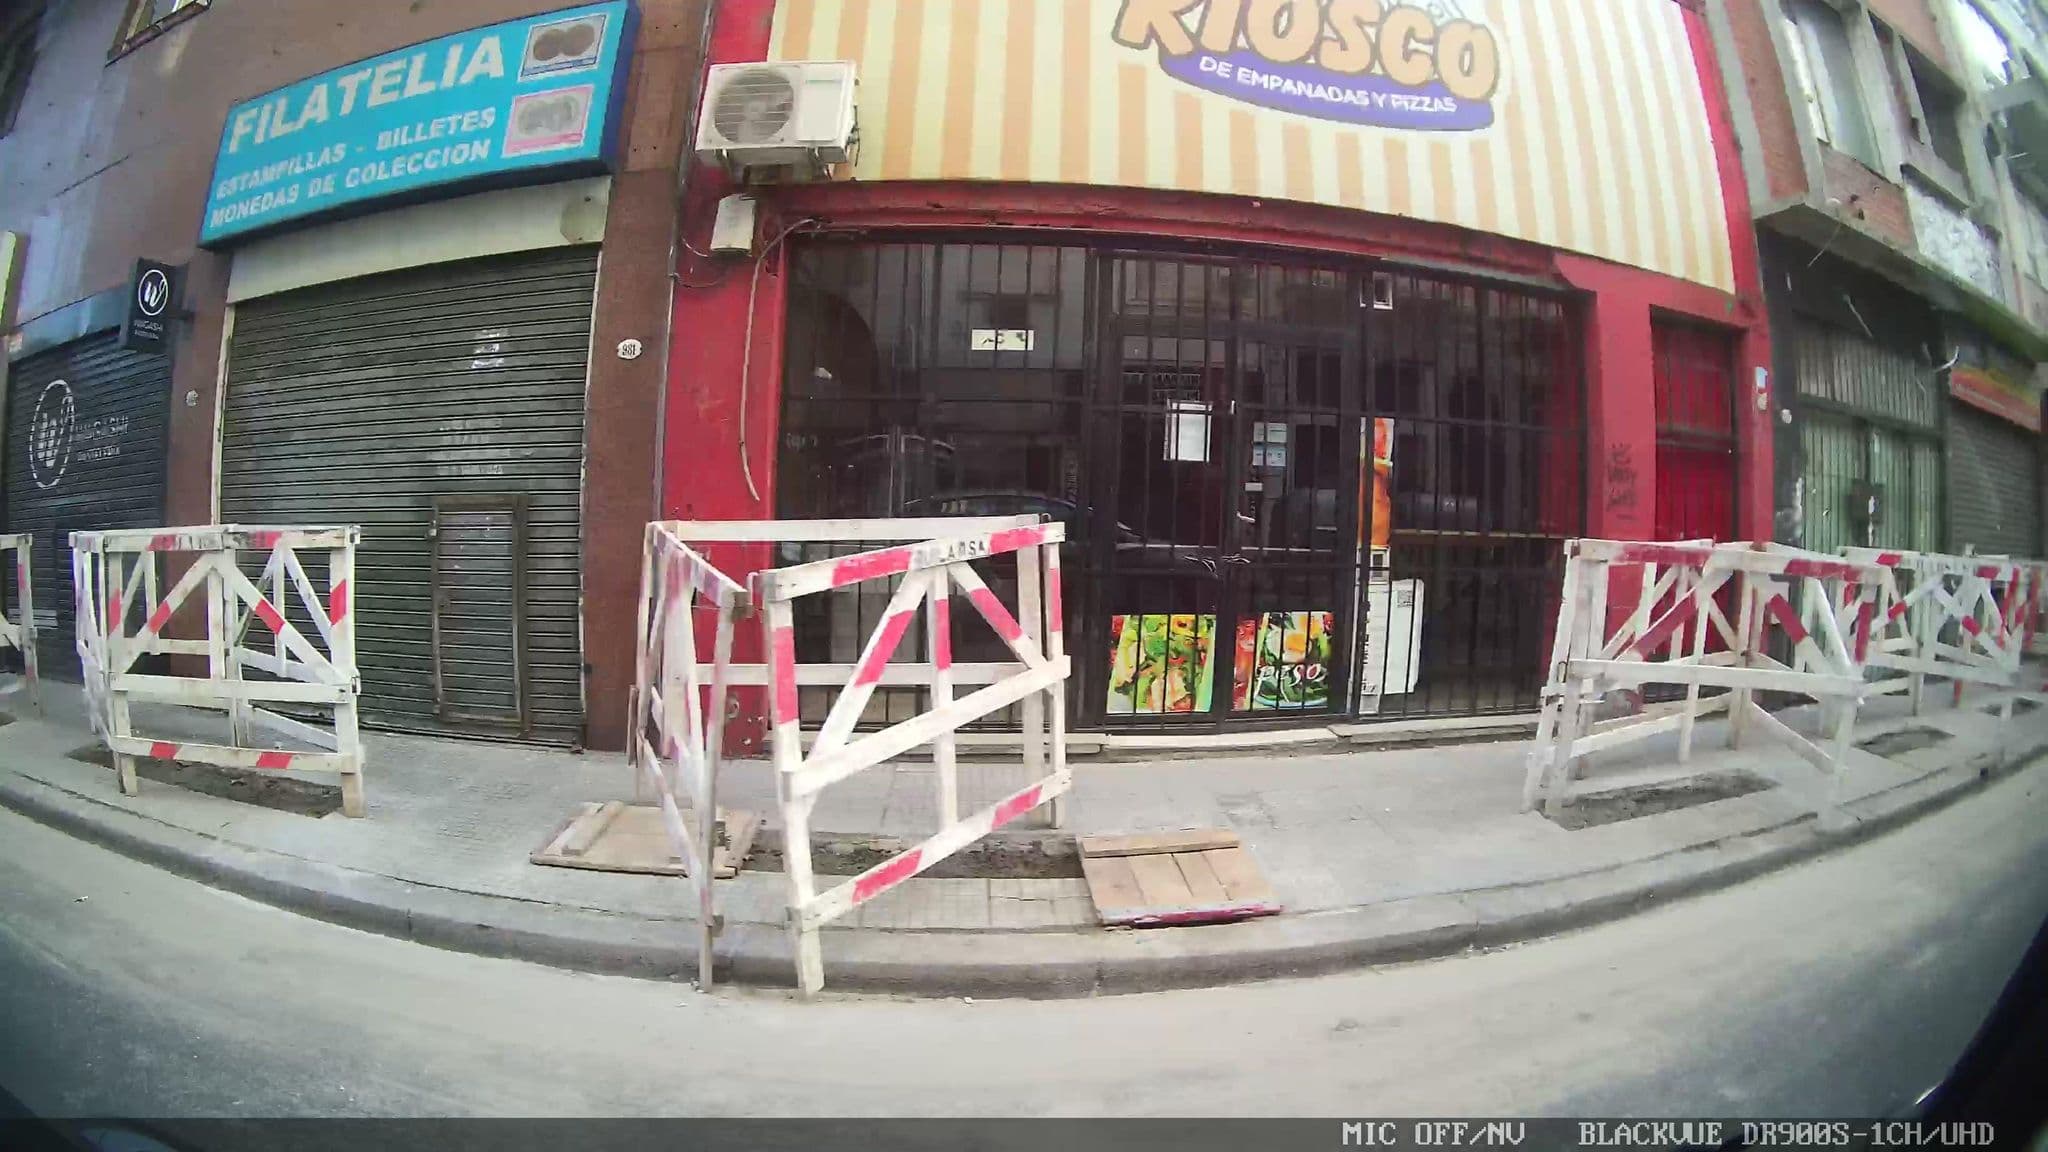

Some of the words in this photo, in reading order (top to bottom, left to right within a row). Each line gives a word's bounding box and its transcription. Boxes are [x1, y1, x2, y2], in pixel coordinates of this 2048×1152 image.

[228, 36, 504, 154] FILATELIA
[1112, 0, 1499, 104] KIOSCO
[1199, 55, 1233, 79] DE
[1237, 67, 1370, 107] EMPANADAS
[1371, 92, 1388, 109] Y
[1390, 94, 1458, 113] PIZZAS
[209, 183, 300, 228] MONEDAS
[307, 172, 337, 198] DE
[345, 139, 491, 189] COLECCION
[216, 143, 347, 200] ESTAMPILLAS
[376, 107, 497, 151] BILLETES
